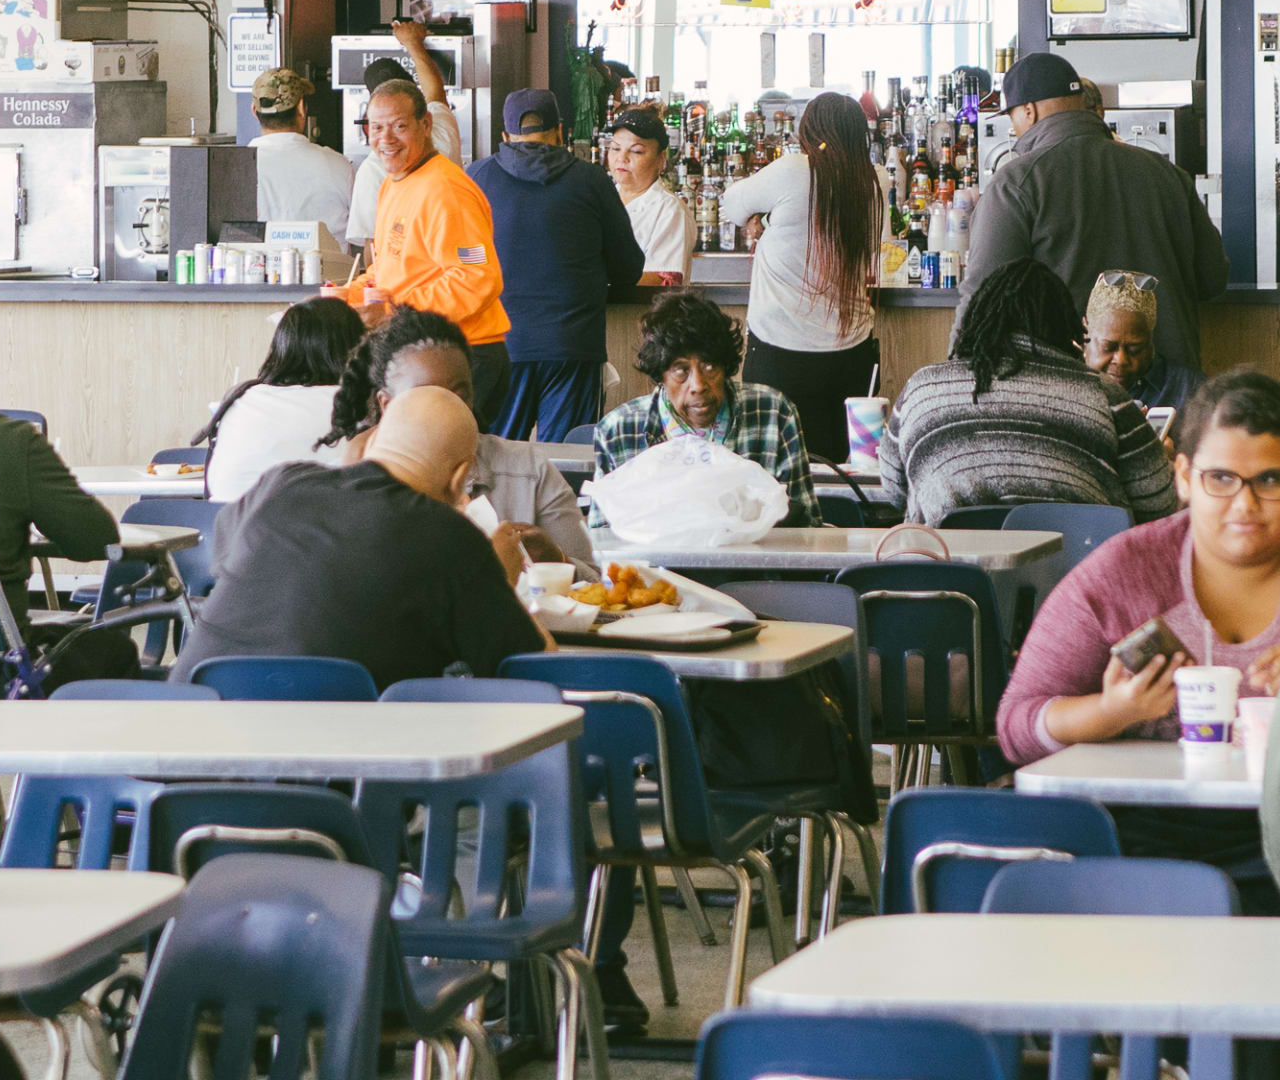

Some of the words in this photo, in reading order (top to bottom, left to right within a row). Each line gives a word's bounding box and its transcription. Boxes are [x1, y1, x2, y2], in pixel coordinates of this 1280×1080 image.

[3, 96, 70, 114] Hennessy
[13, 112, 61, 126] Colada
[271, 231, 291, 239] CASH
[292, 231, 311, 240] ONLY
